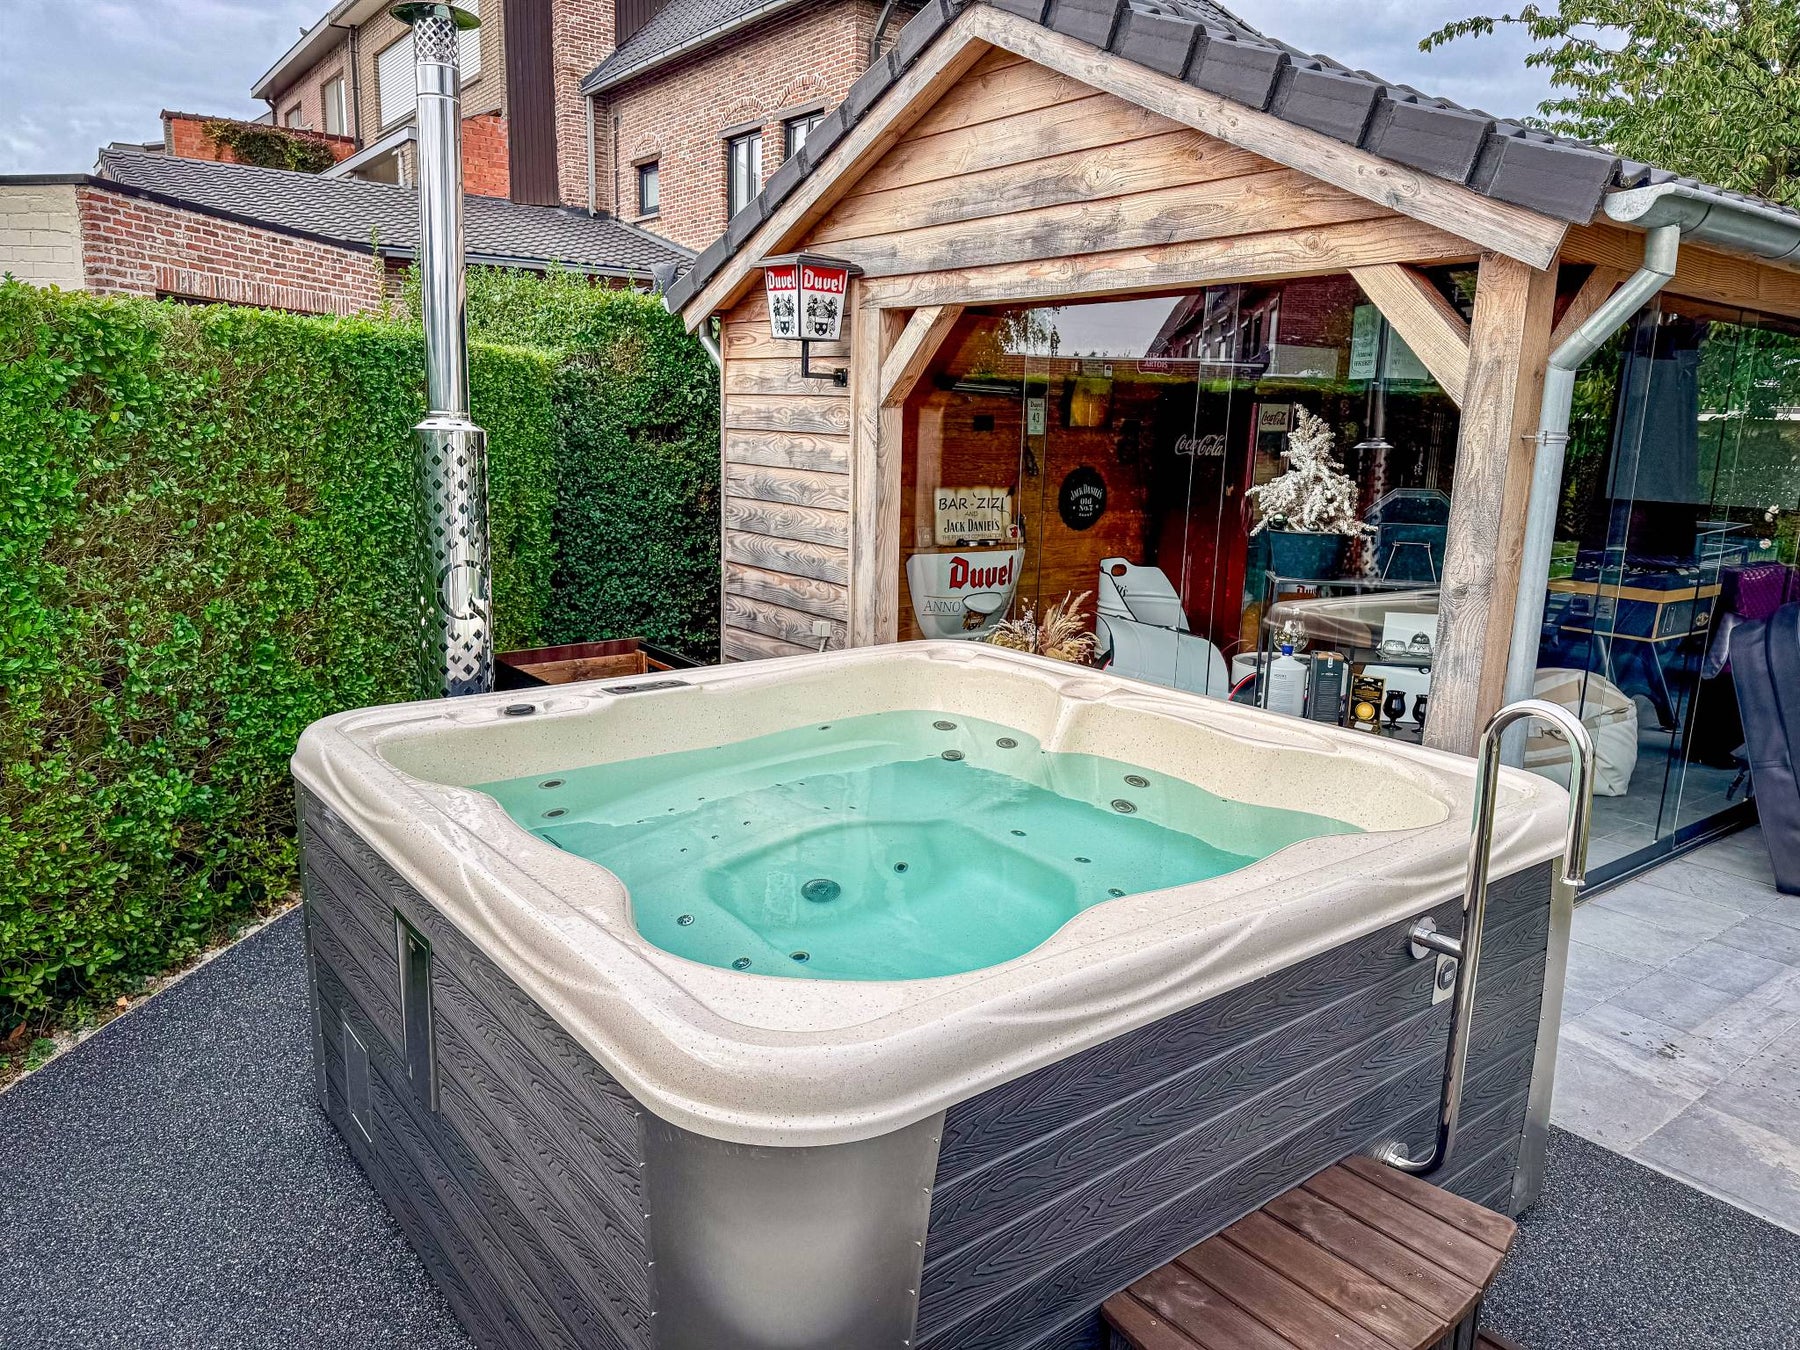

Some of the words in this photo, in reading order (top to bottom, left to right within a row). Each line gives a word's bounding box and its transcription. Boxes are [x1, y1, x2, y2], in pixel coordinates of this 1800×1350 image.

[767, 269, 796, 290] Duvel
[803, 268, 843, 292] Duvel
[1031, 412, 1040, 423] 43
[1070, 486, 1083, 501] JACK
[1079, 497, 1092, 505] Old
[938, 497, 968, 511] BAR
[943, 518, 966, 534] JACK
[967, 517, 1000, 532] DANIEL'S
[948, 555, 1014, 590] Duvel
[923, 599, 962, 613] ANNO
